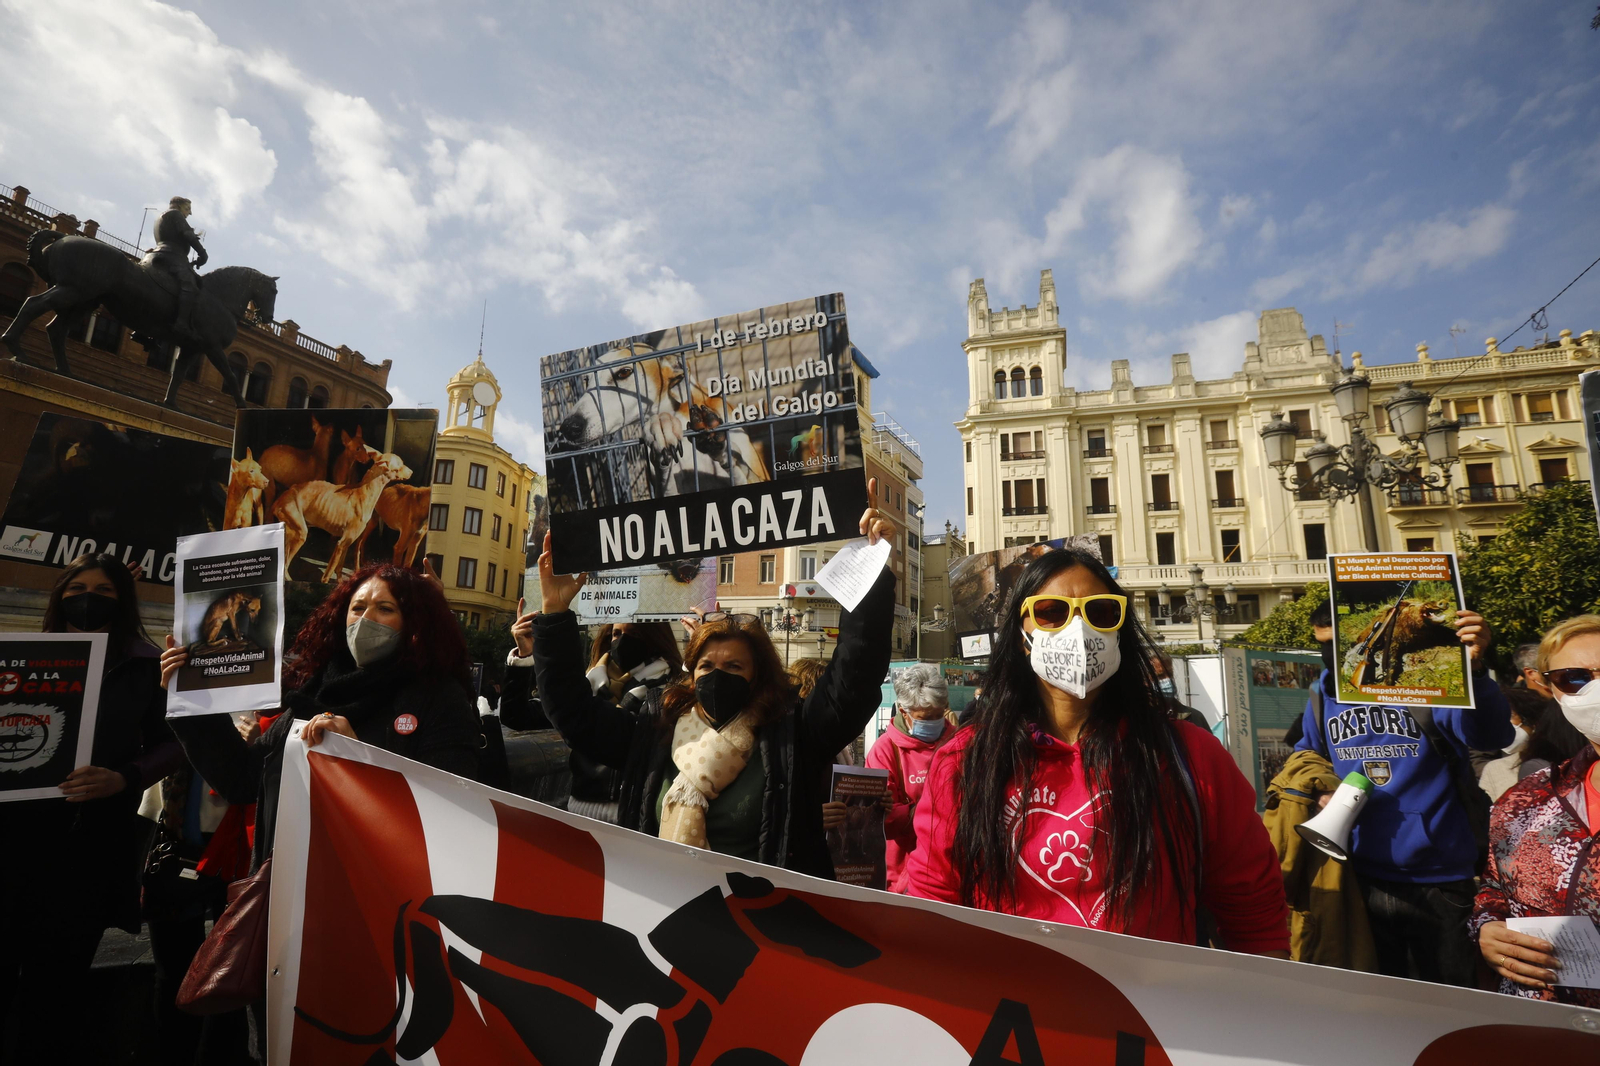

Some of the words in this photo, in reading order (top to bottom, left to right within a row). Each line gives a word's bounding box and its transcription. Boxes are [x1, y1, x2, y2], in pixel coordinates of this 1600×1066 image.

[695, 332, 704, 352] 1
[710, 328, 737, 349] de
[744, 312, 828, 343] Febrero
[706, 372, 741, 398] Día
[748, 353, 834, 390] Mundial
[731, 398, 766, 424] del
[772, 390, 838, 416] Galgo
[774, 460, 804, 472] Galgos
[806, 456, 820, 466] del
[822, 454, 838, 464] Sur
[598, 513, 646, 564] NO
[652, 510, 676, 557] A
[678, 502, 728, 554] LA
[731, 486, 836, 546] CAZA
[52, 534, 97, 567] NO
[581, 591, 592, 600] DE
[594, 590, 637, 600] ANIMALES
[595, 606, 620, 615] VIVOS
[1041, 637, 1052, 648] LA
[1055, 639, 1079, 652] CAZA
[28, 660, 86, 668] VIOLENCIA
[190, 650, 265, 666] #RespetoVidaAnimal
[1042, 652, 1082, 667] DEPORTE
[1086, 652, 1098, 666] ES
[204, 664, 250, 675] #NoALaCaza
[22, 680, 83, 694] CAZA
[1237, 656, 1250, 711] personas
[1362, 687, 1442, 696] #RespetoVidaAnimal
[1327, 705, 1422, 745] OXFORD
[1335, 743, 1420, 761] UNIVERSITY
